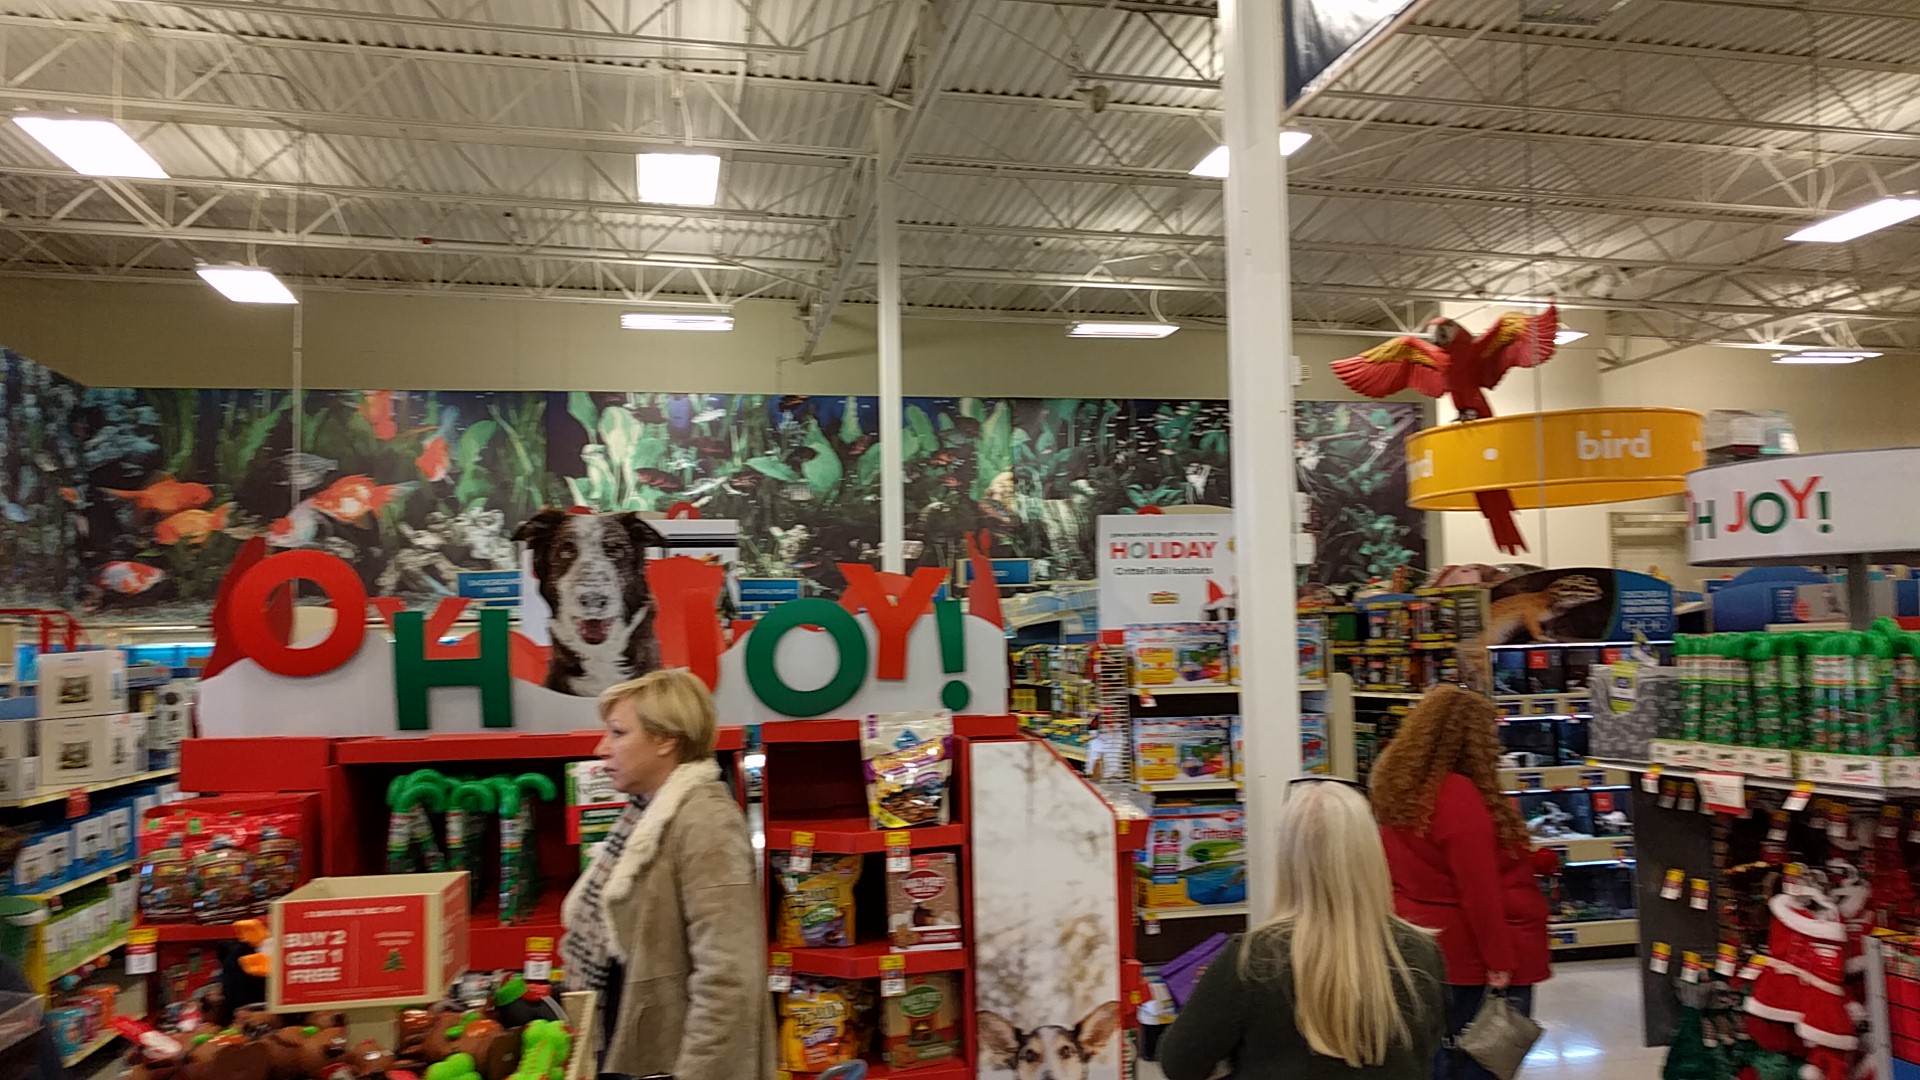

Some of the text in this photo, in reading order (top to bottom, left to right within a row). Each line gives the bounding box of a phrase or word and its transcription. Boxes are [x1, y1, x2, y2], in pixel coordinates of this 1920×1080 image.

[1576, 429, 1651, 460] bird
[1724, 475, 1834, 534] JOY!
[1109, 541, 1218, 559] HOLIDAY
[227, 548, 513, 731] OH
[283, 929, 347, 948] BUY 2
[286, 948, 344, 966] GET 1
[286, 966, 342, 985] FREE
